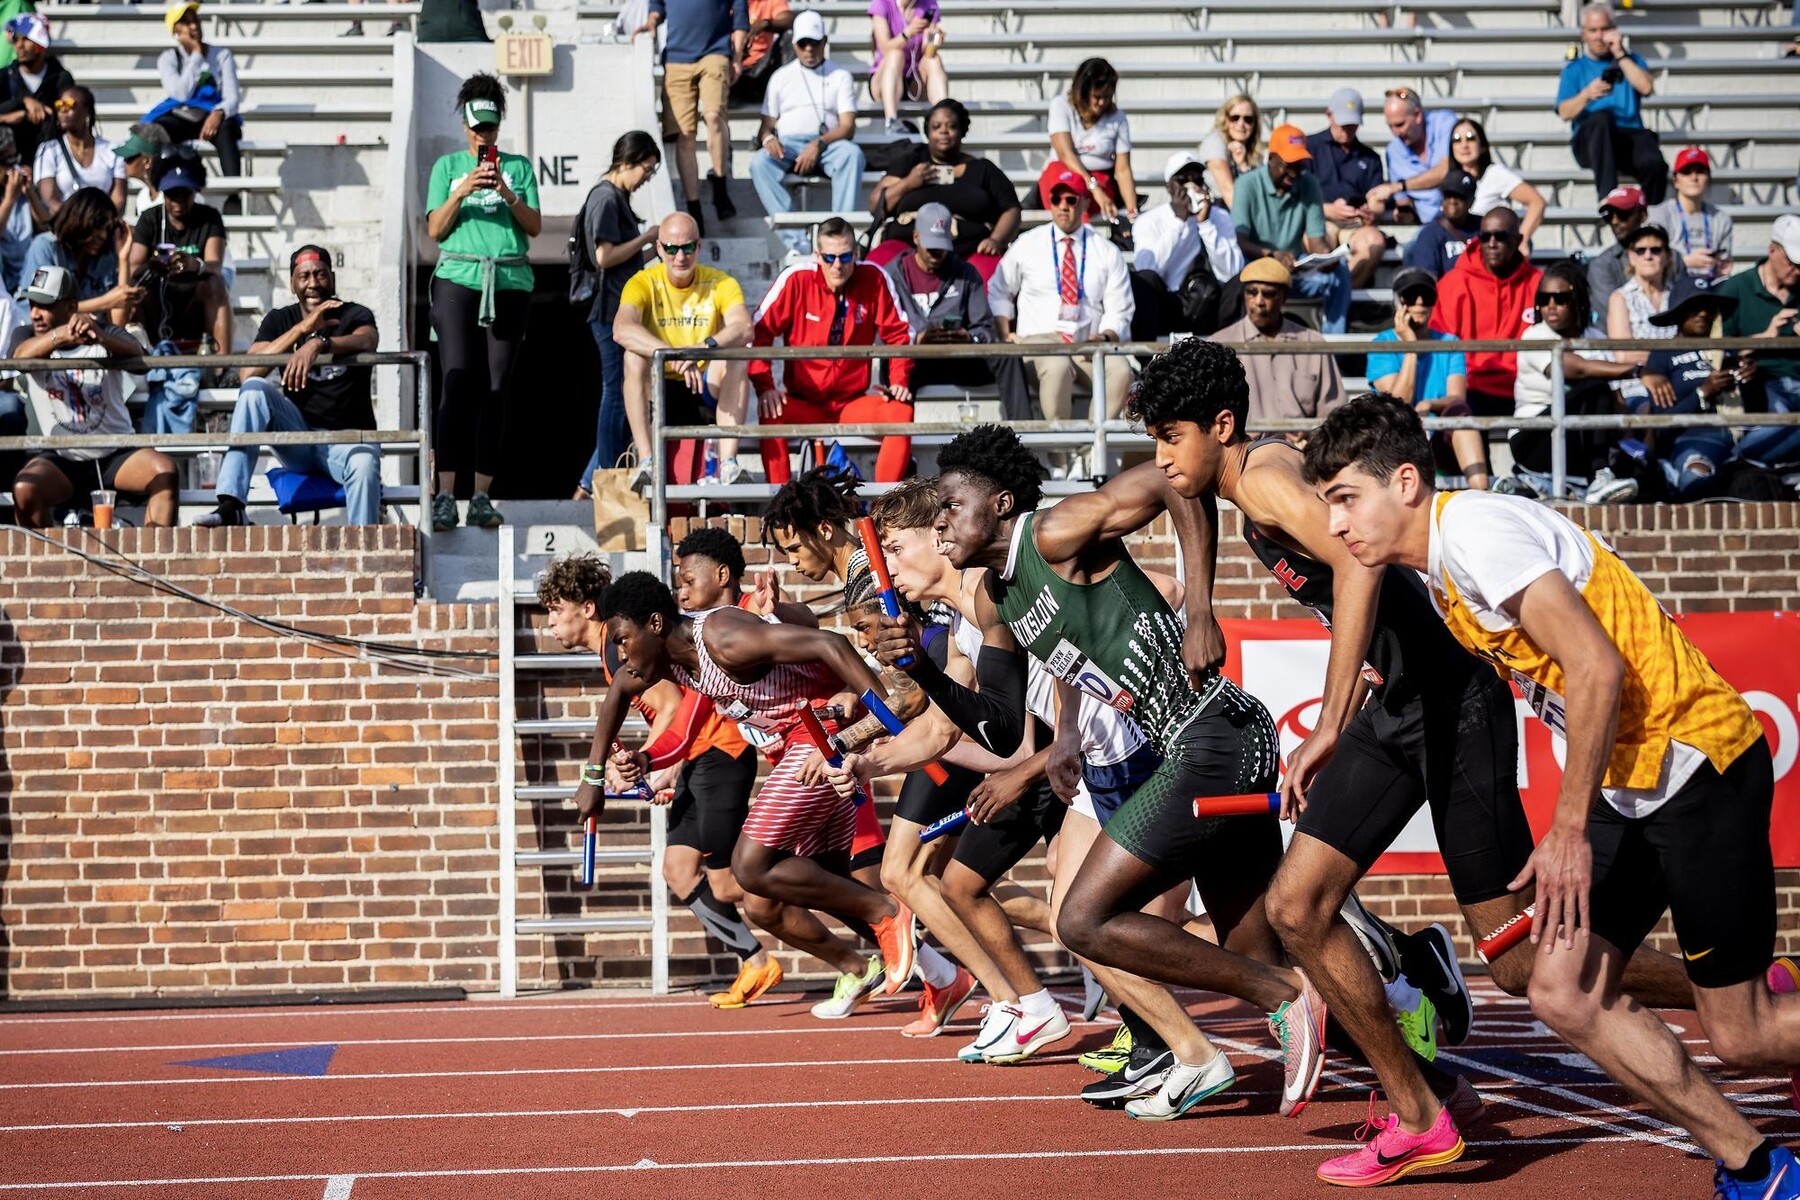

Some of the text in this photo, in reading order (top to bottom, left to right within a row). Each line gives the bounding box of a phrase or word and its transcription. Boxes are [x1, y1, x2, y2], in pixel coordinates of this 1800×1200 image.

[507, 38, 544, 69] EXIT
[539, 155, 579, 186] NE
[545, 532, 555, 552] 2
[1009, 584, 1060, 647] WINSLOW
[1050, 649, 1064, 668] PENN
[1056, 650, 1074, 674] RELAYS
[1483, 914, 1525, 941] TOYOTA
